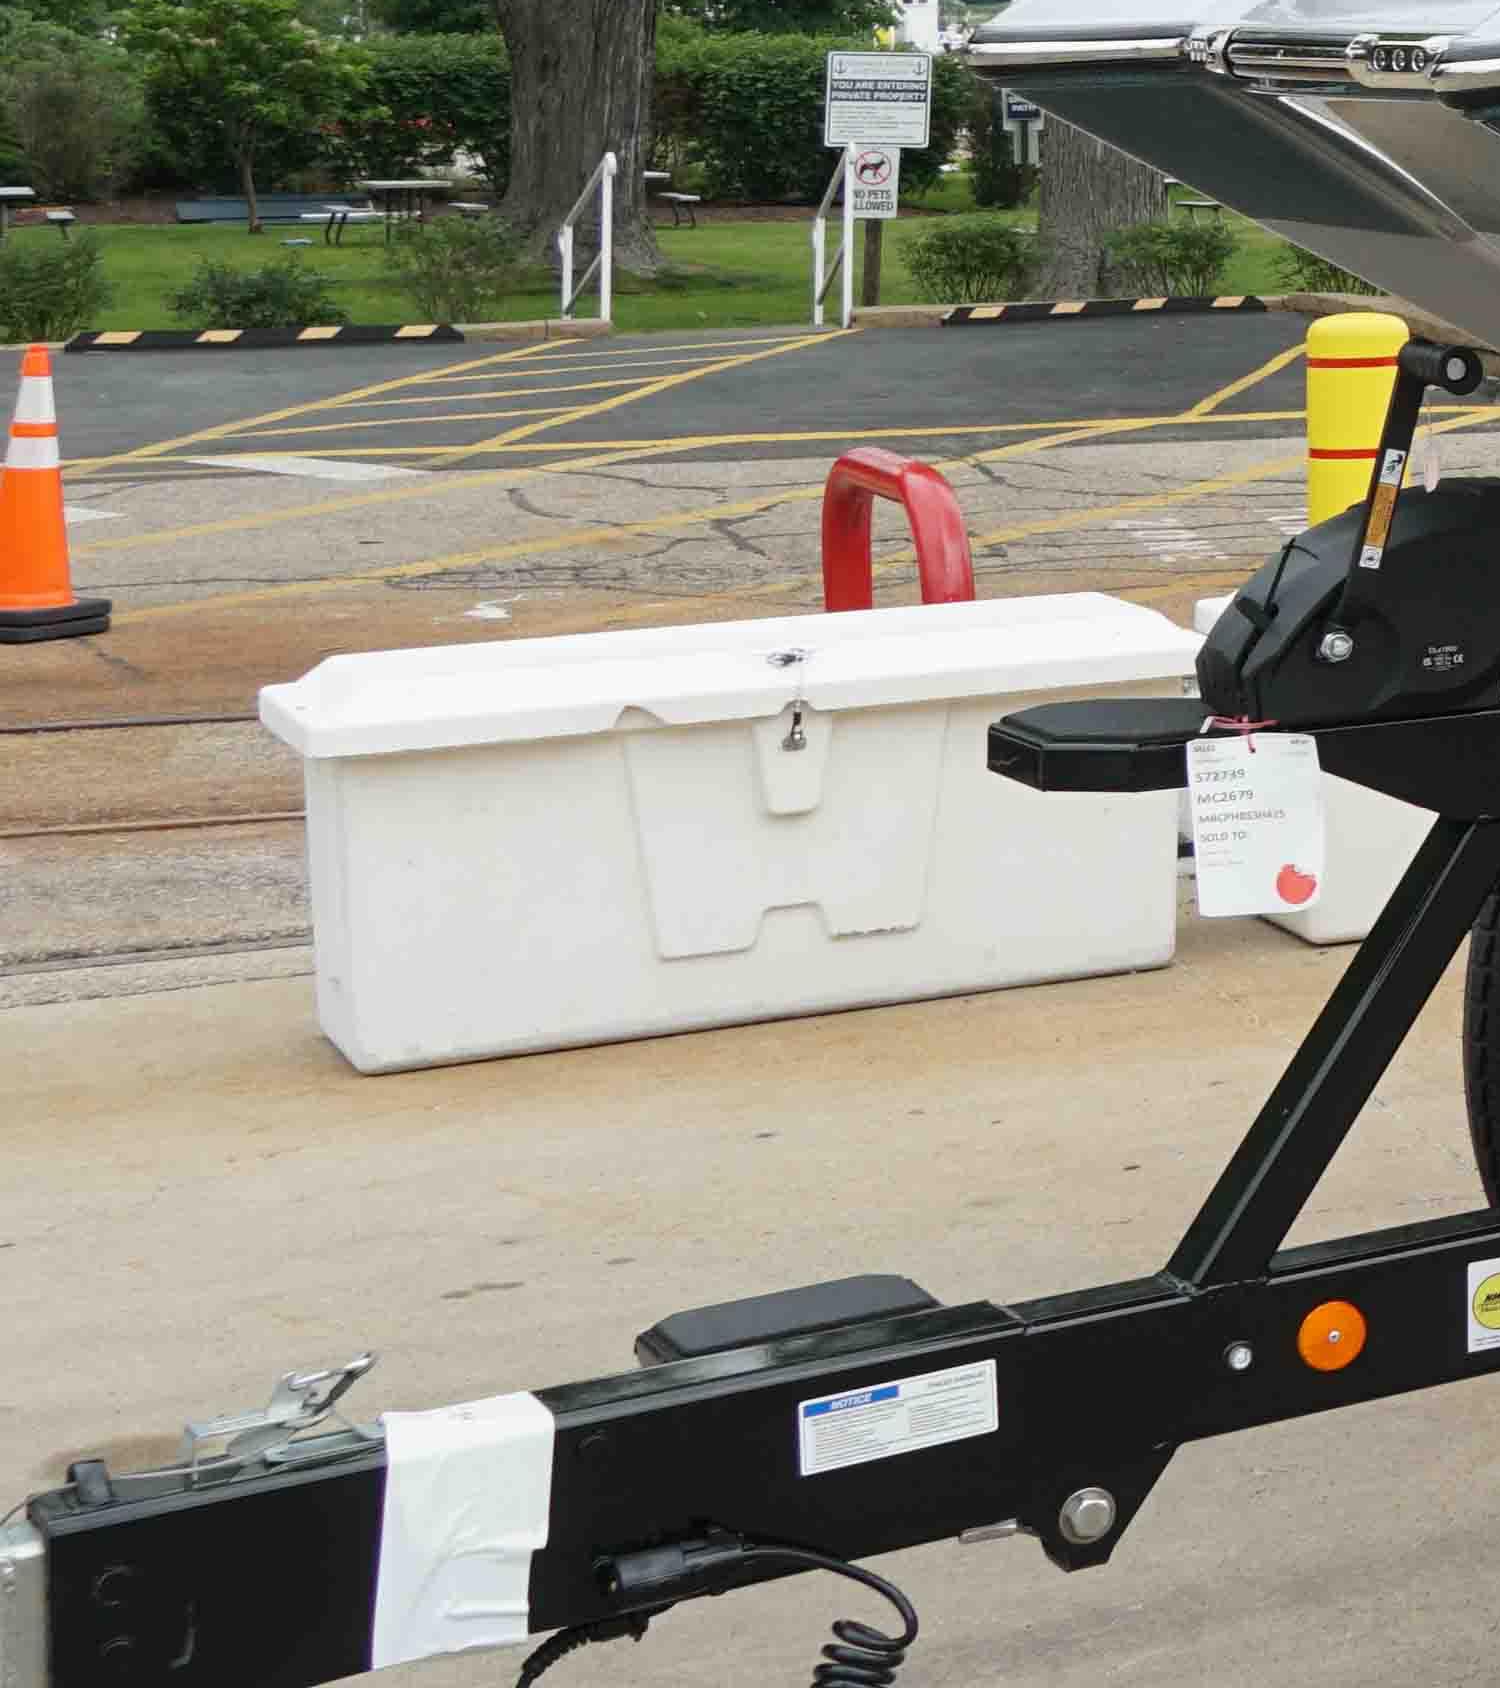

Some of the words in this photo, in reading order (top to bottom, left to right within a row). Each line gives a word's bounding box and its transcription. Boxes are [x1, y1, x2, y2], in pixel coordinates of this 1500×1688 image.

[832, 80, 853, 89] YOU
[854, 199, 893, 211] LLOWED
[831, 1392, 873, 1410] NOTICE
